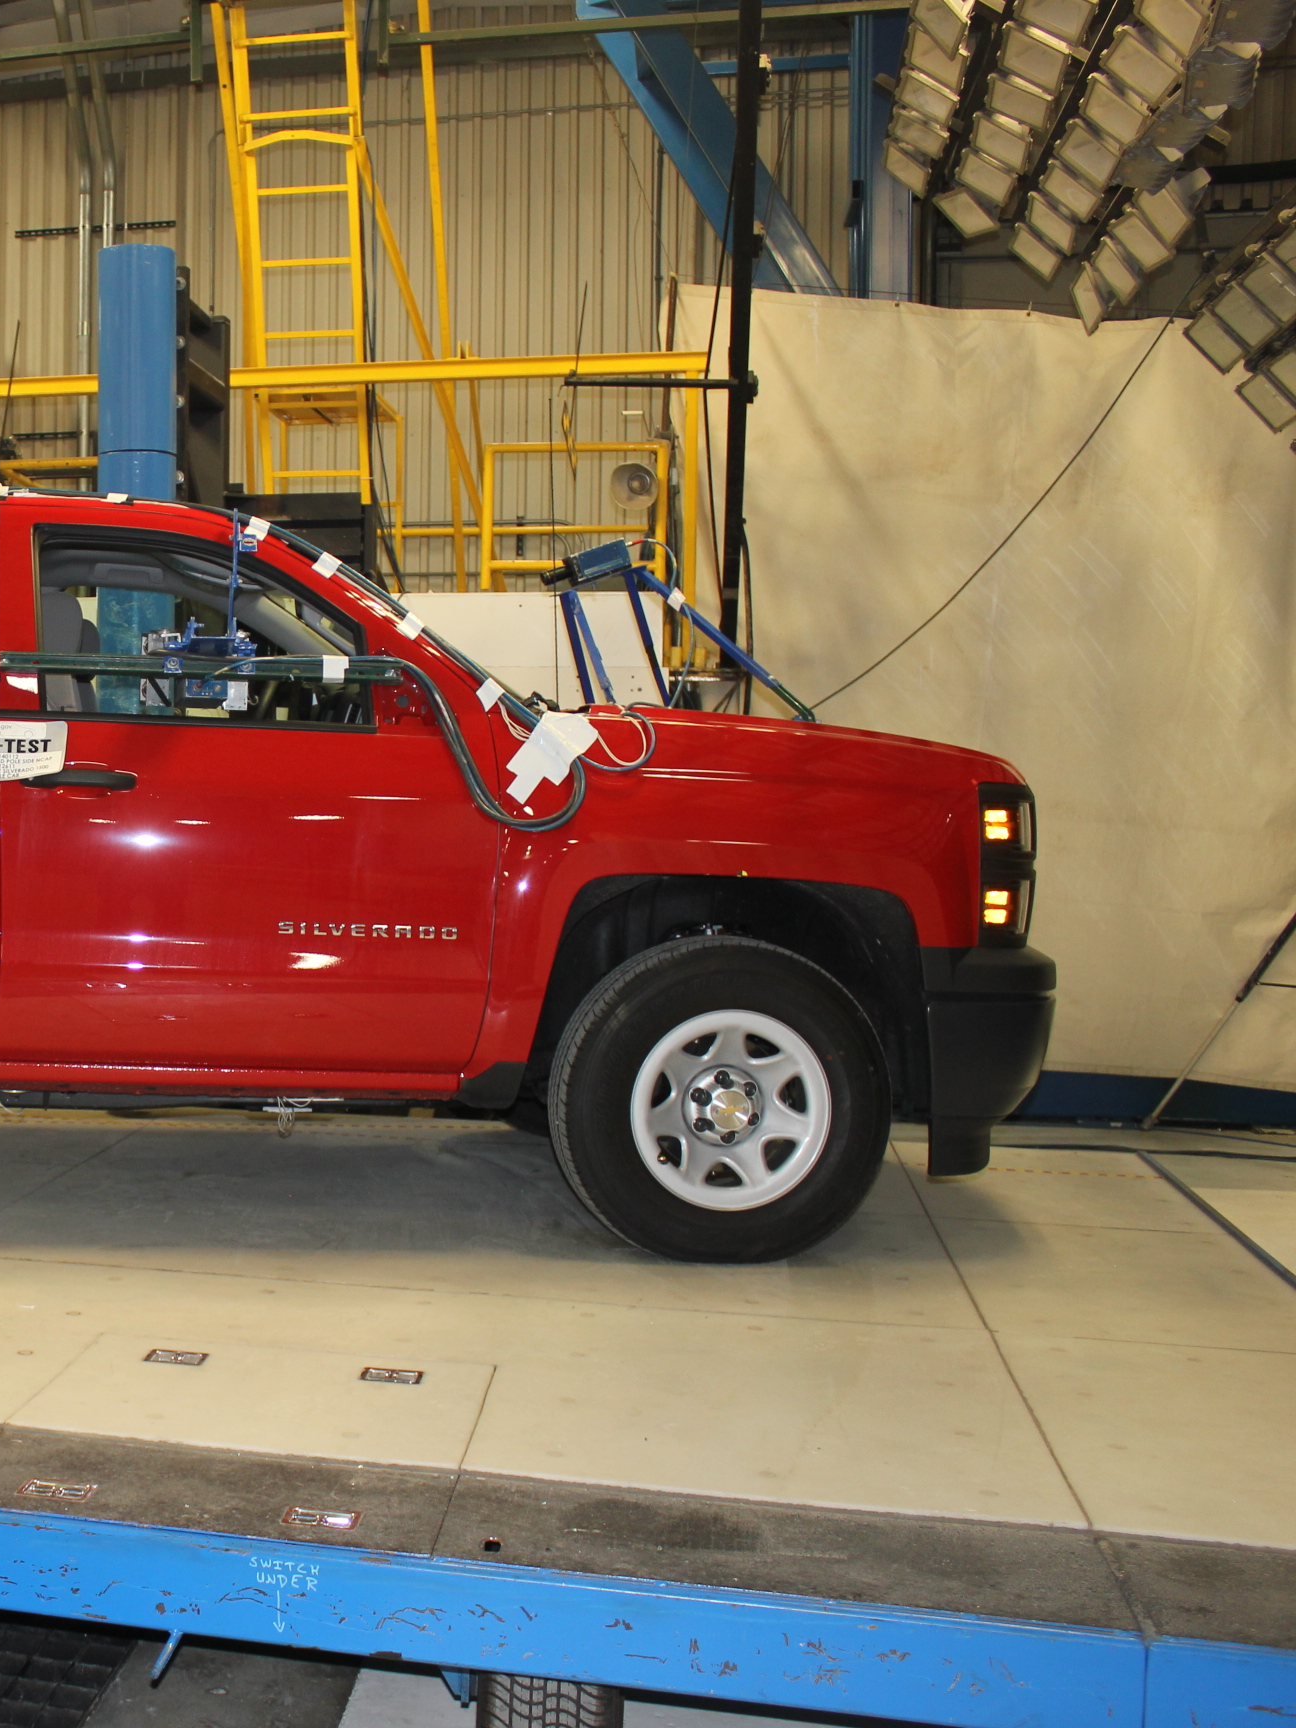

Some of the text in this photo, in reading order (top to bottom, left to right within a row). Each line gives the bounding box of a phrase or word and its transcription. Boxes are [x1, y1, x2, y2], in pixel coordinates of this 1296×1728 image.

[278, 921, 458, 940] SILVERADO
[249, 1556, 320, 1576] SWITCH
[256, 1571, 318, 1592] UNDER
